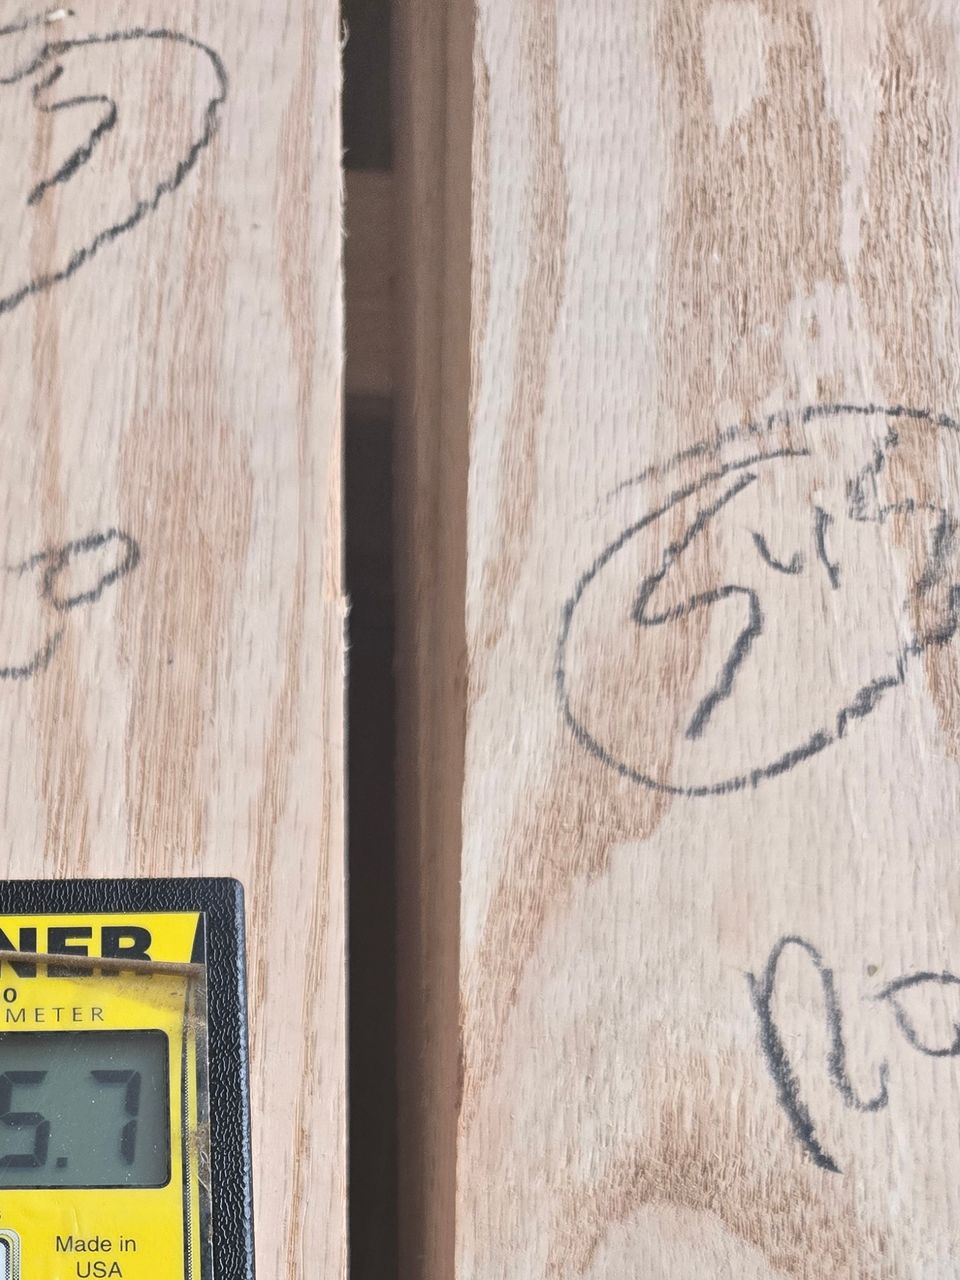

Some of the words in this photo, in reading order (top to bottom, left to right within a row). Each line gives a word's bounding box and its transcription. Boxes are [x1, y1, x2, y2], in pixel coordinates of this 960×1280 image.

[5, 1006, 105, 1023] METER
[56, 1235, 111, 1253] Made
[119, 1235, 137, 1252] in
[76, 1260, 123, 1279] USA
